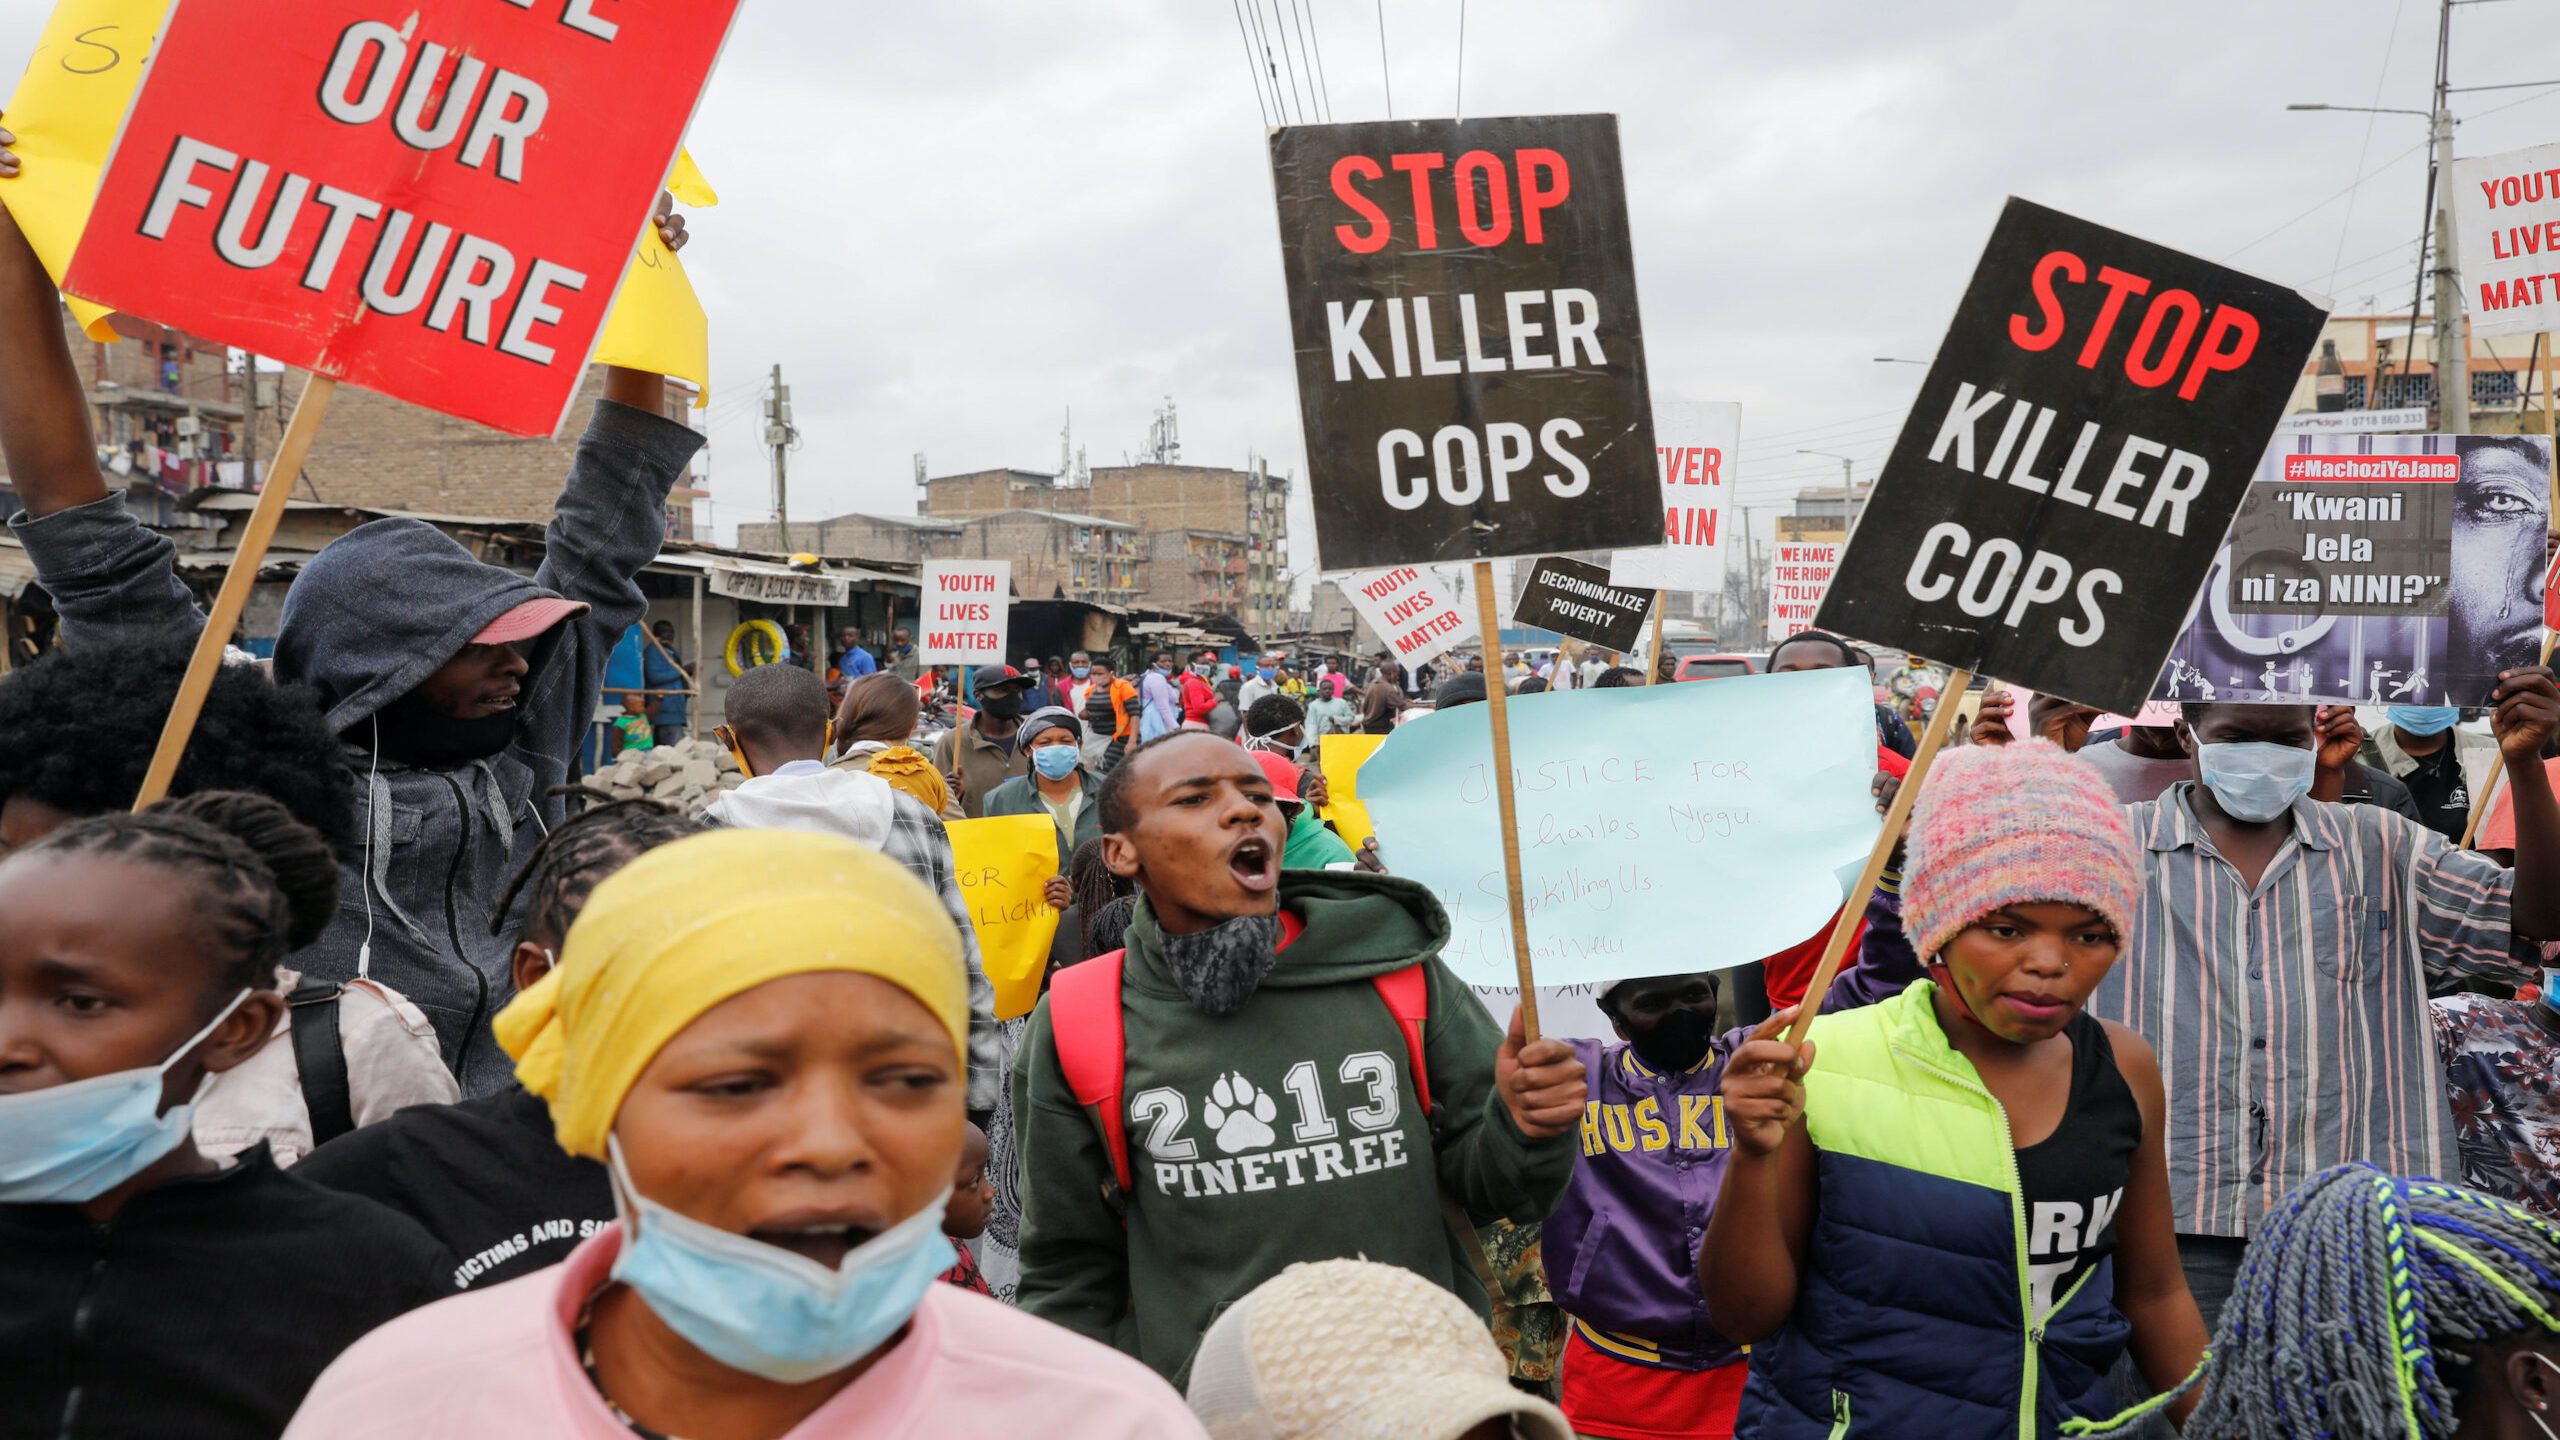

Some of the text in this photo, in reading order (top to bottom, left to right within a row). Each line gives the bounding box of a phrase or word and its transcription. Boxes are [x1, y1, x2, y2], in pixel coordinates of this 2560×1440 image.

[317, 20, 549, 184] OUR
[1330, 148, 1570, 254] STOP
[137, 134, 588, 366] FUTURE
[1326, 288, 1608, 381] KILLER
[2008, 250, 2260, 401] STOP
[1377, 418, 1591, 511] COPS
[1656, 447, 1722, 485] VER
[1928, 381, 2210, 537] KILLER
[2289, 459, 2456, 478] #MachoziYaJana
[1780, 547, 1835, 562] WE HAVE
[2302, 533, 2373, 562] Jela
[938, 574, 995, 592] YOUTH
[1361, 567, 1419, 602] YOUTH
[1538, 569, 1647, 613] DECRIMINALIZE
[1776, 566, 1834, 582] THE RIGH
[1784, 586, 1825, 600] TO LIV
[1905, 521, 2123, 647] COPS
[2241, 574, 2275, 602] ni
[2283, 577, 2320, 602] za
[940, 603, 990, 621] LIVES
[1384, 590, 1434, 626] LIVES
[1550, 598, 1616, 628] POVERTY
[928, 632, 998, 650] MATTER
[1395, 610, 1463, 655] MATTER
[1691, 760, 1752, 782] FOR
[1514, 813, 1640, 851] harles
[955, 866, 1008, 888] OR
[1580, 1095, 1734, 1157] HUSKI
[1154, 1129, 1408, 1198] PINETREE
[453, 1233, 530, 1290] VICTIMS
[531, 1219, 575, 1246] AND
